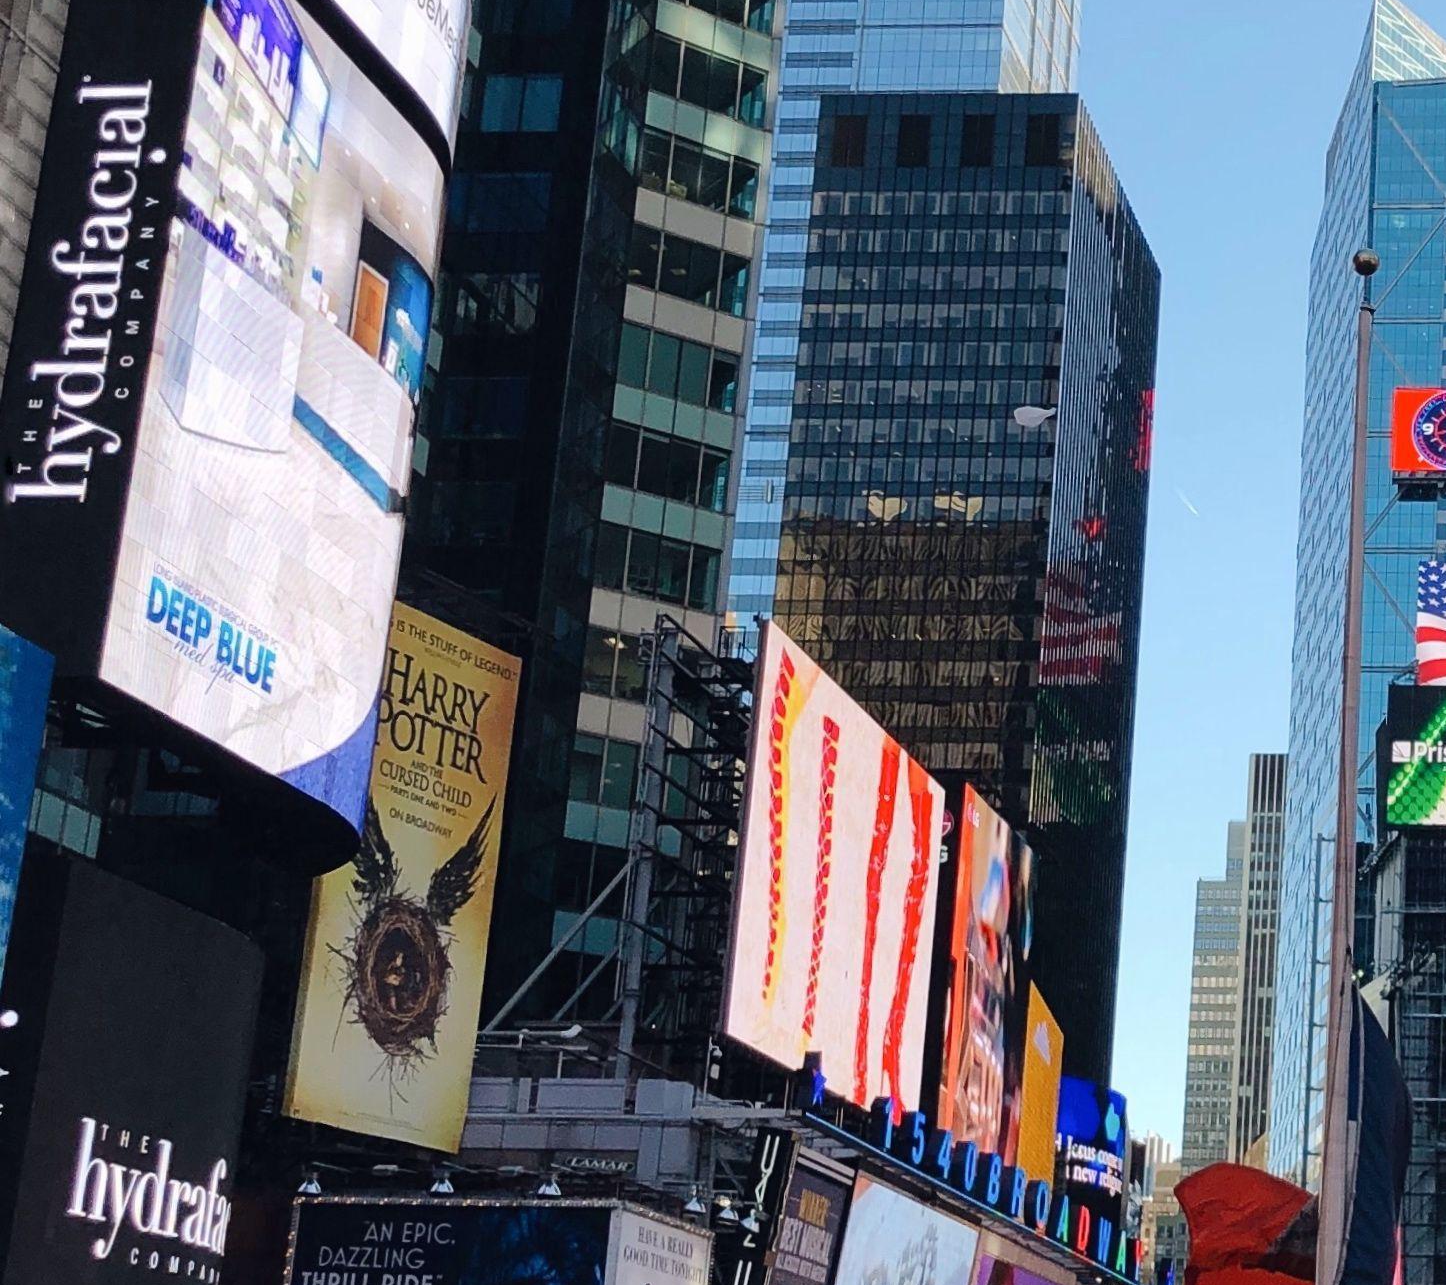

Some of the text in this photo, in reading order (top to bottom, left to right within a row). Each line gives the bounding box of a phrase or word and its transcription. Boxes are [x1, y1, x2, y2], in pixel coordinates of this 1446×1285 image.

[116, 194, 161, 400] COMPANY
[1422, 423, 1434, 435] 9
[146, 575, 276, 694] DEEP BLUE
[396, 618, 406, 633] IS
[408, 623, 427, 644] THE
[429, 633, 458, 657] STUFF
[459, 647, 474, 664] OF
[384, 647, 491, 735] HARRY
[377, 696, 488, 785] POTTER
[379, 758, 472, 809] CURSED CHILD
[101, 1124, 151, 1154] THE
[884, 1097, 978, 1192] 1540
[570, 1157, 630, 1172] LAMAR
[318, 1246, 425, 1269] DAZZLING
[623, 1245, 649, 1268] GOOD
[638, 1226, 659, 1249] HAVE
